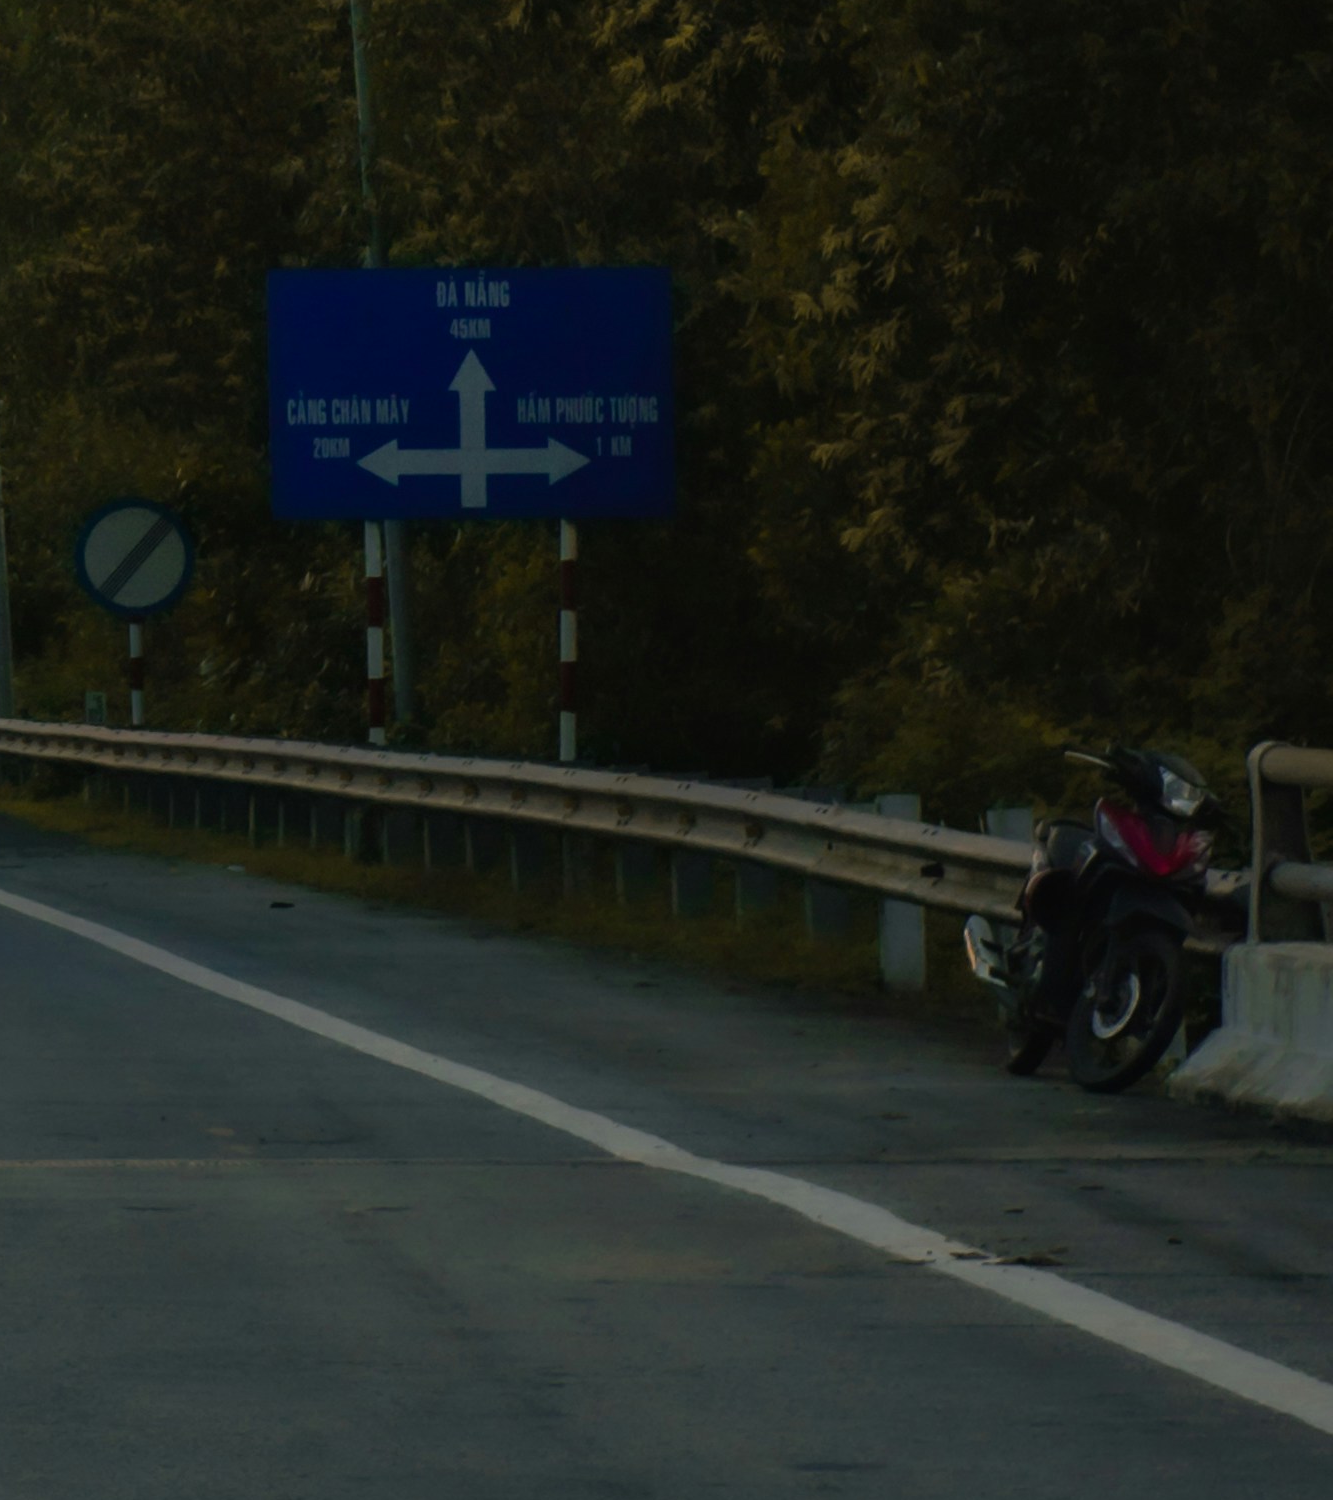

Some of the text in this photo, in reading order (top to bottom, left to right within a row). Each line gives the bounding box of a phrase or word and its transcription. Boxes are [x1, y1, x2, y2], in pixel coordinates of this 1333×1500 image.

[436, 270, 510, 308] ĐÀ NẴNG
[449, 318, 491, 339] 45KM
[313, 437, 350, 458] 20KM
[596, 435, 632, 457] 1 KM
